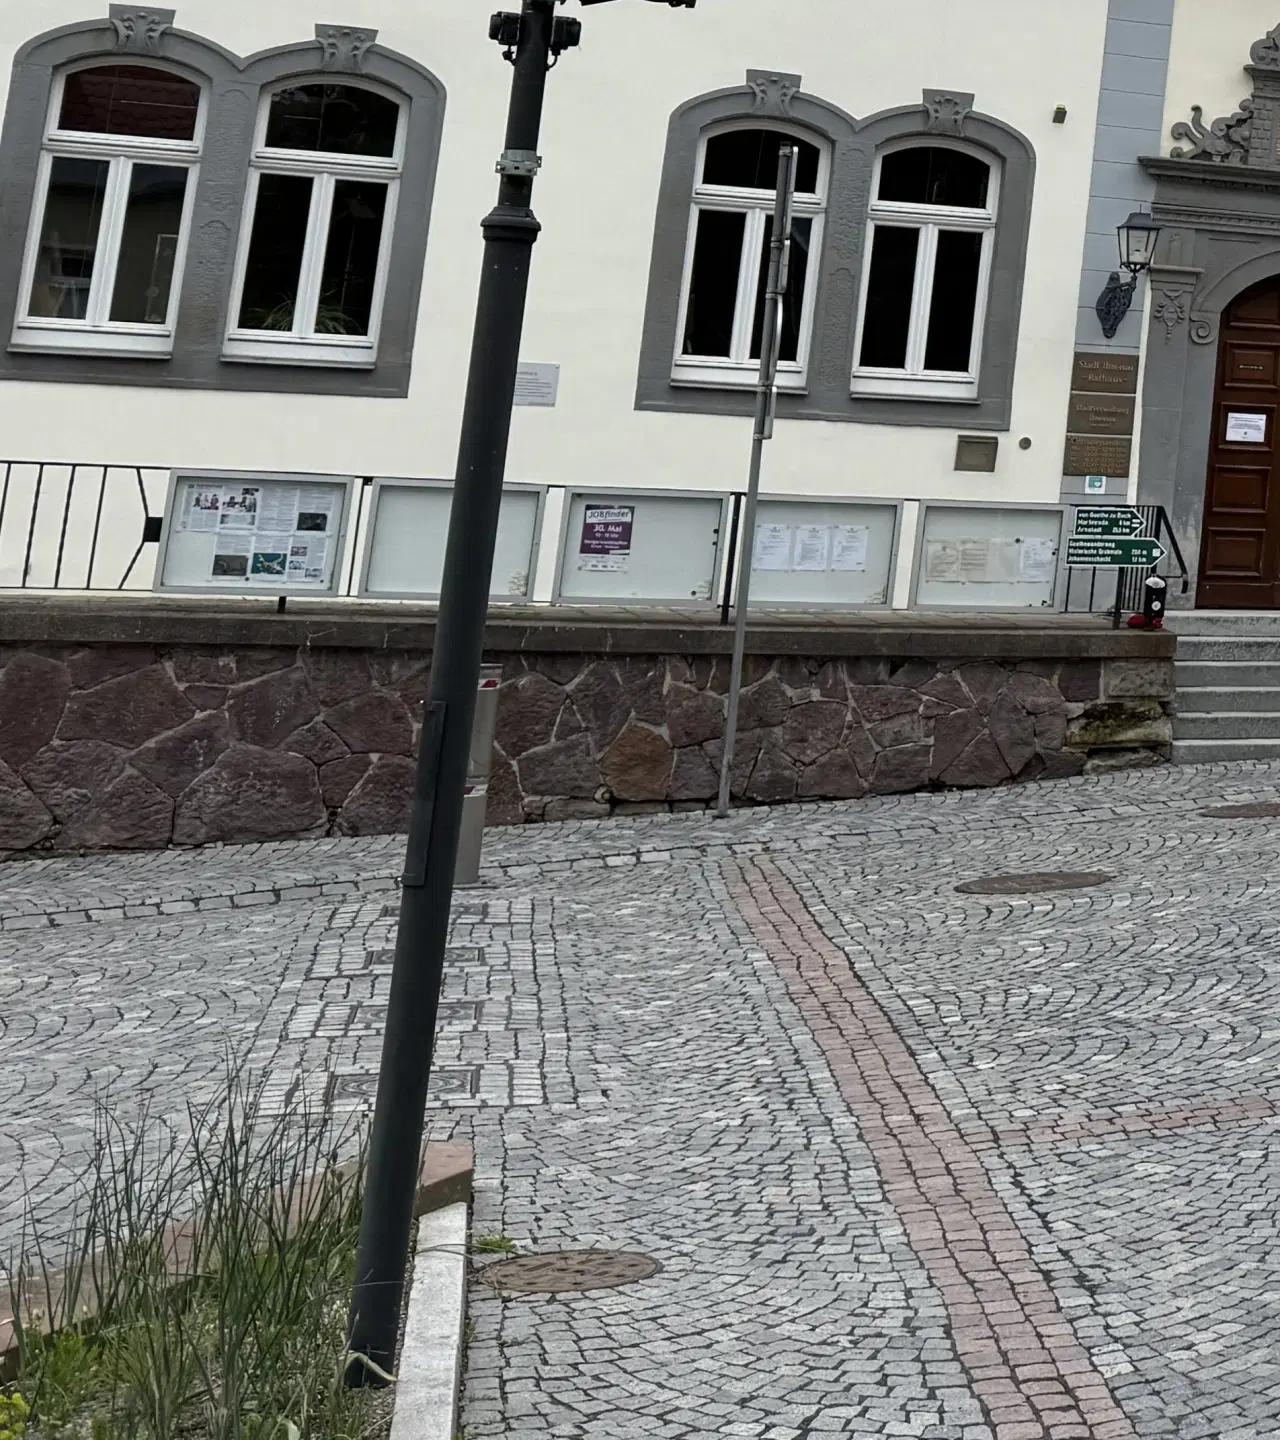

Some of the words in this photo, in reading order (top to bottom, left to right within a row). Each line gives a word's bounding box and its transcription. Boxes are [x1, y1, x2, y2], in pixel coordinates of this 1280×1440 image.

[1078, 360, 1100, 369] Stadt
[1102, 361, 1134, 371] Ilmenau
[588, 510, 630, 519] JOBfinder
[1089, 511, 1109, 519] Goethe
[607, 524, 622, 532] Mai
